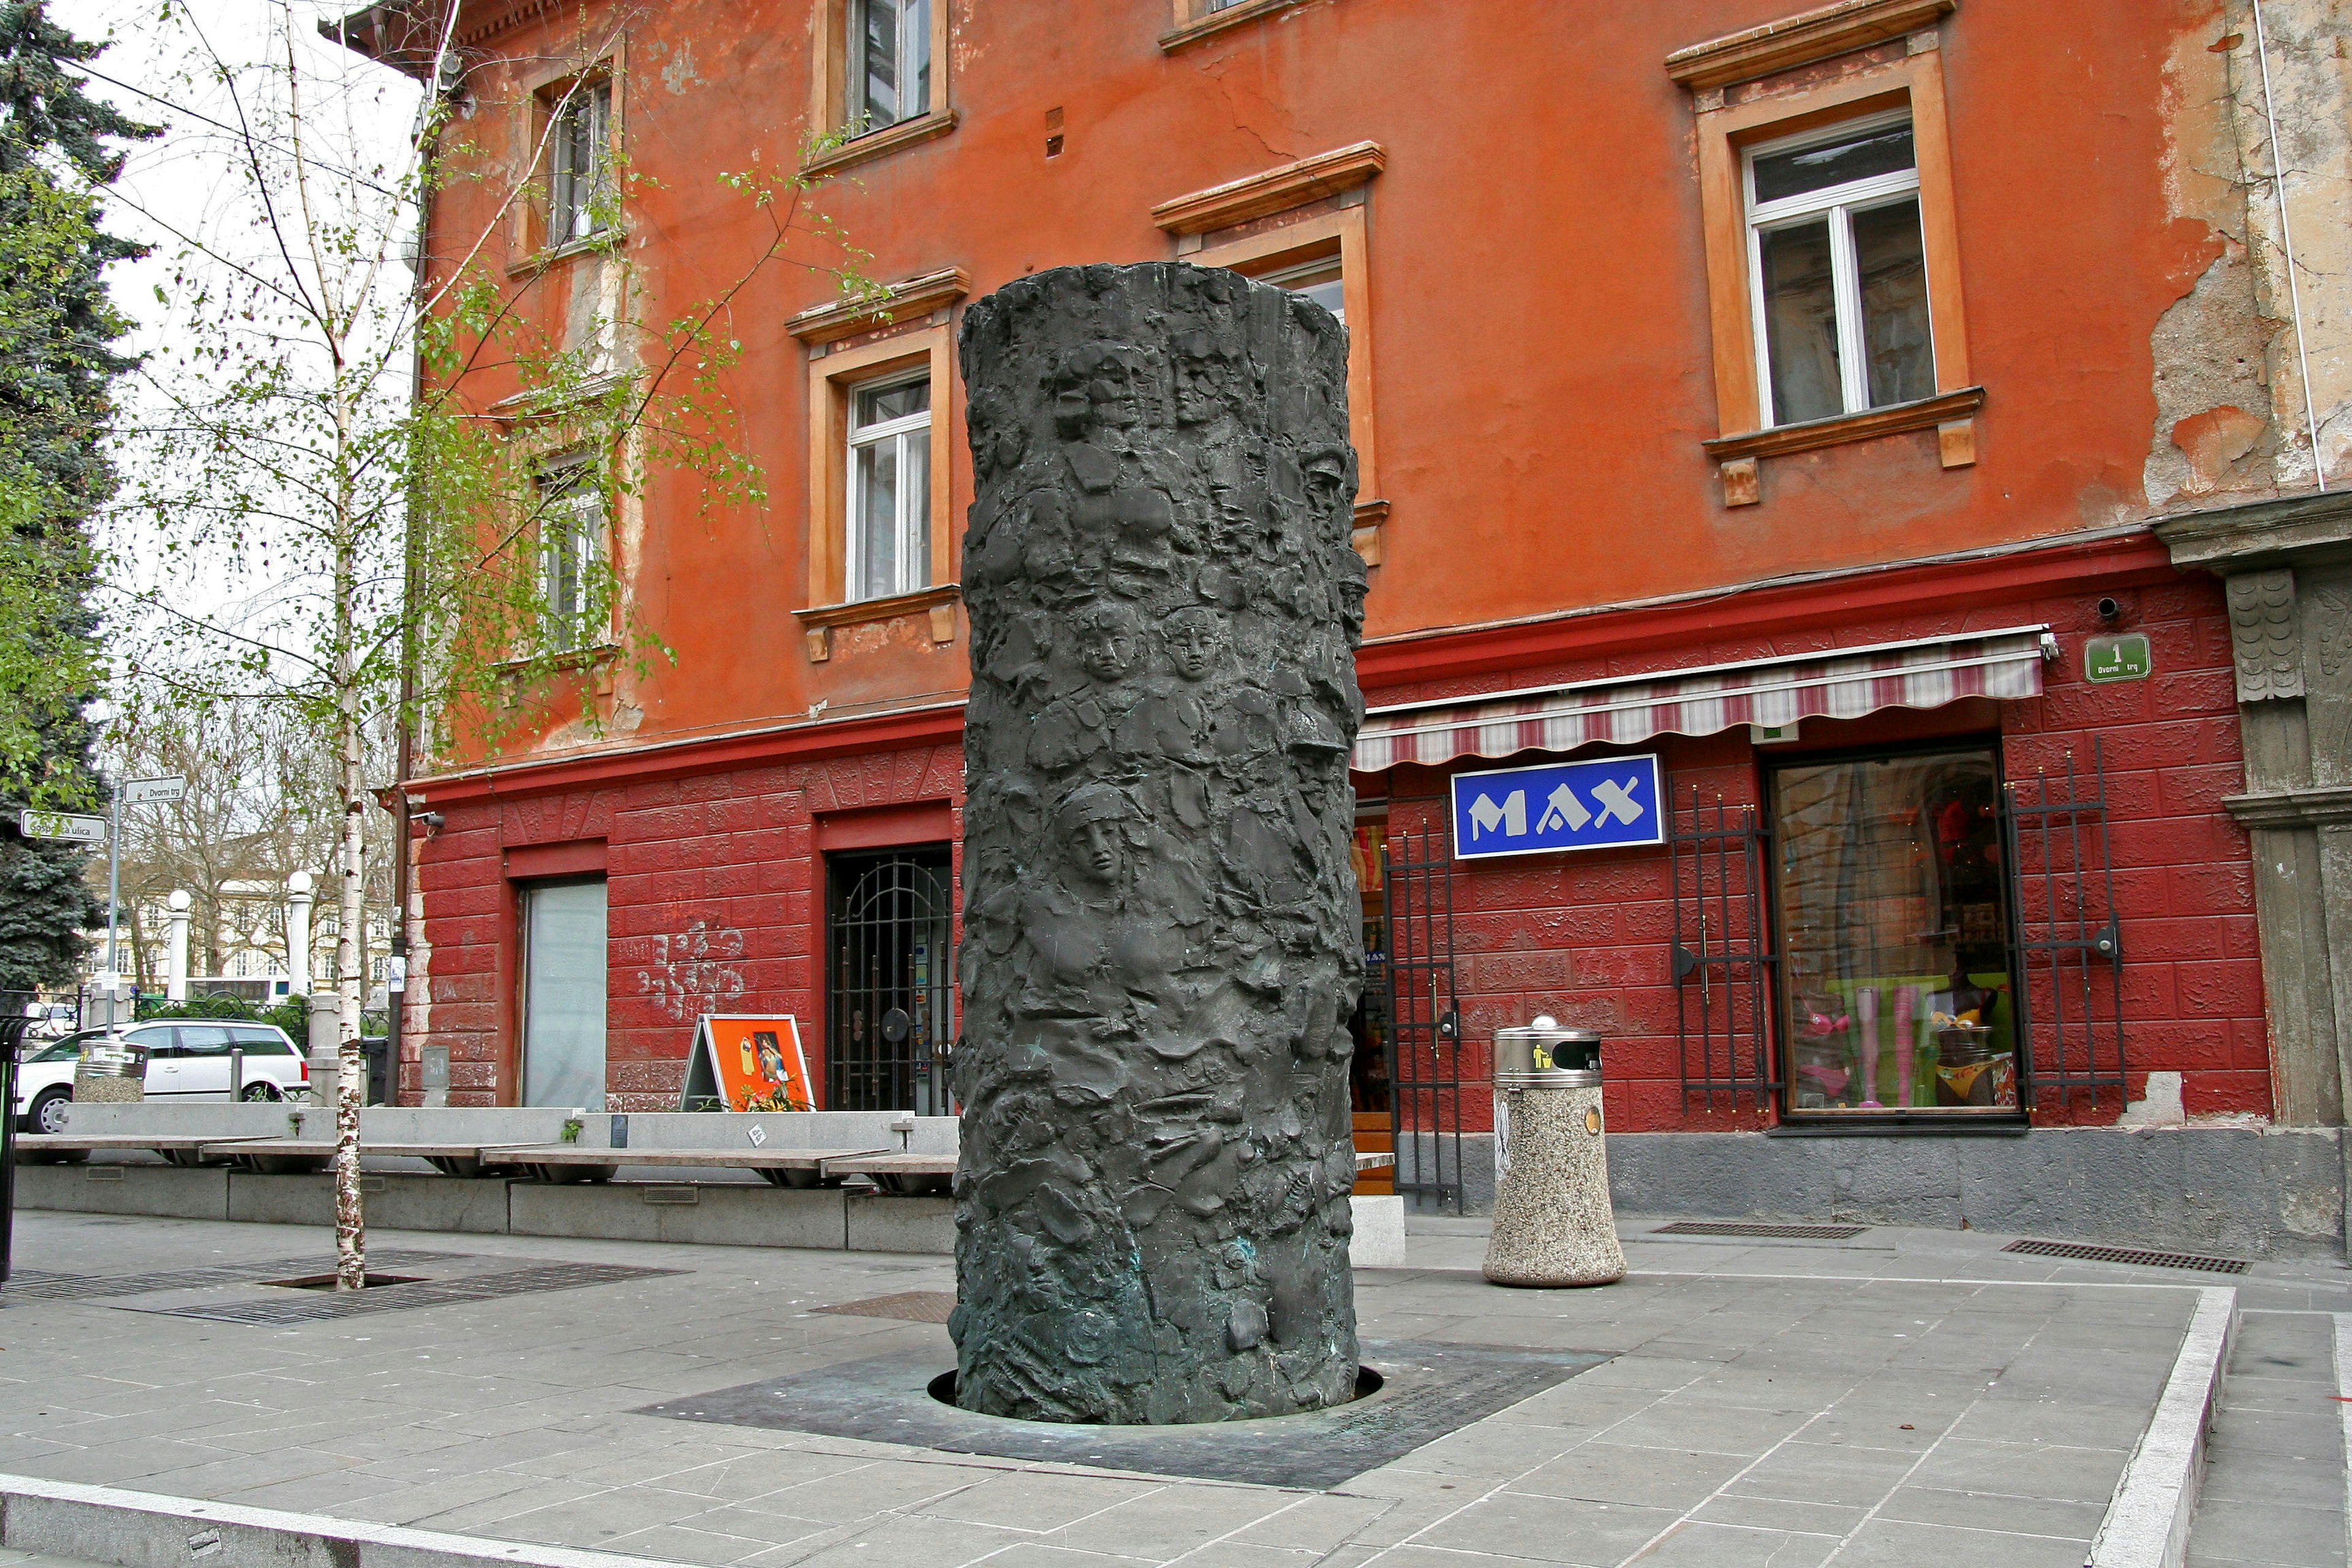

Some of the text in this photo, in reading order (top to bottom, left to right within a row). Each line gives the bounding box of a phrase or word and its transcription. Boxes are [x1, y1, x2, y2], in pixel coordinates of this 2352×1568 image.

[2113, 644, 2122, 663] 1
[2098, 663, 2138, 674] Dvorni trg
[149, 788, 180, 797] Dvorni trg
[1468, 775, 1644, 842] MAX
[72, 826, 91, 835] ulica
